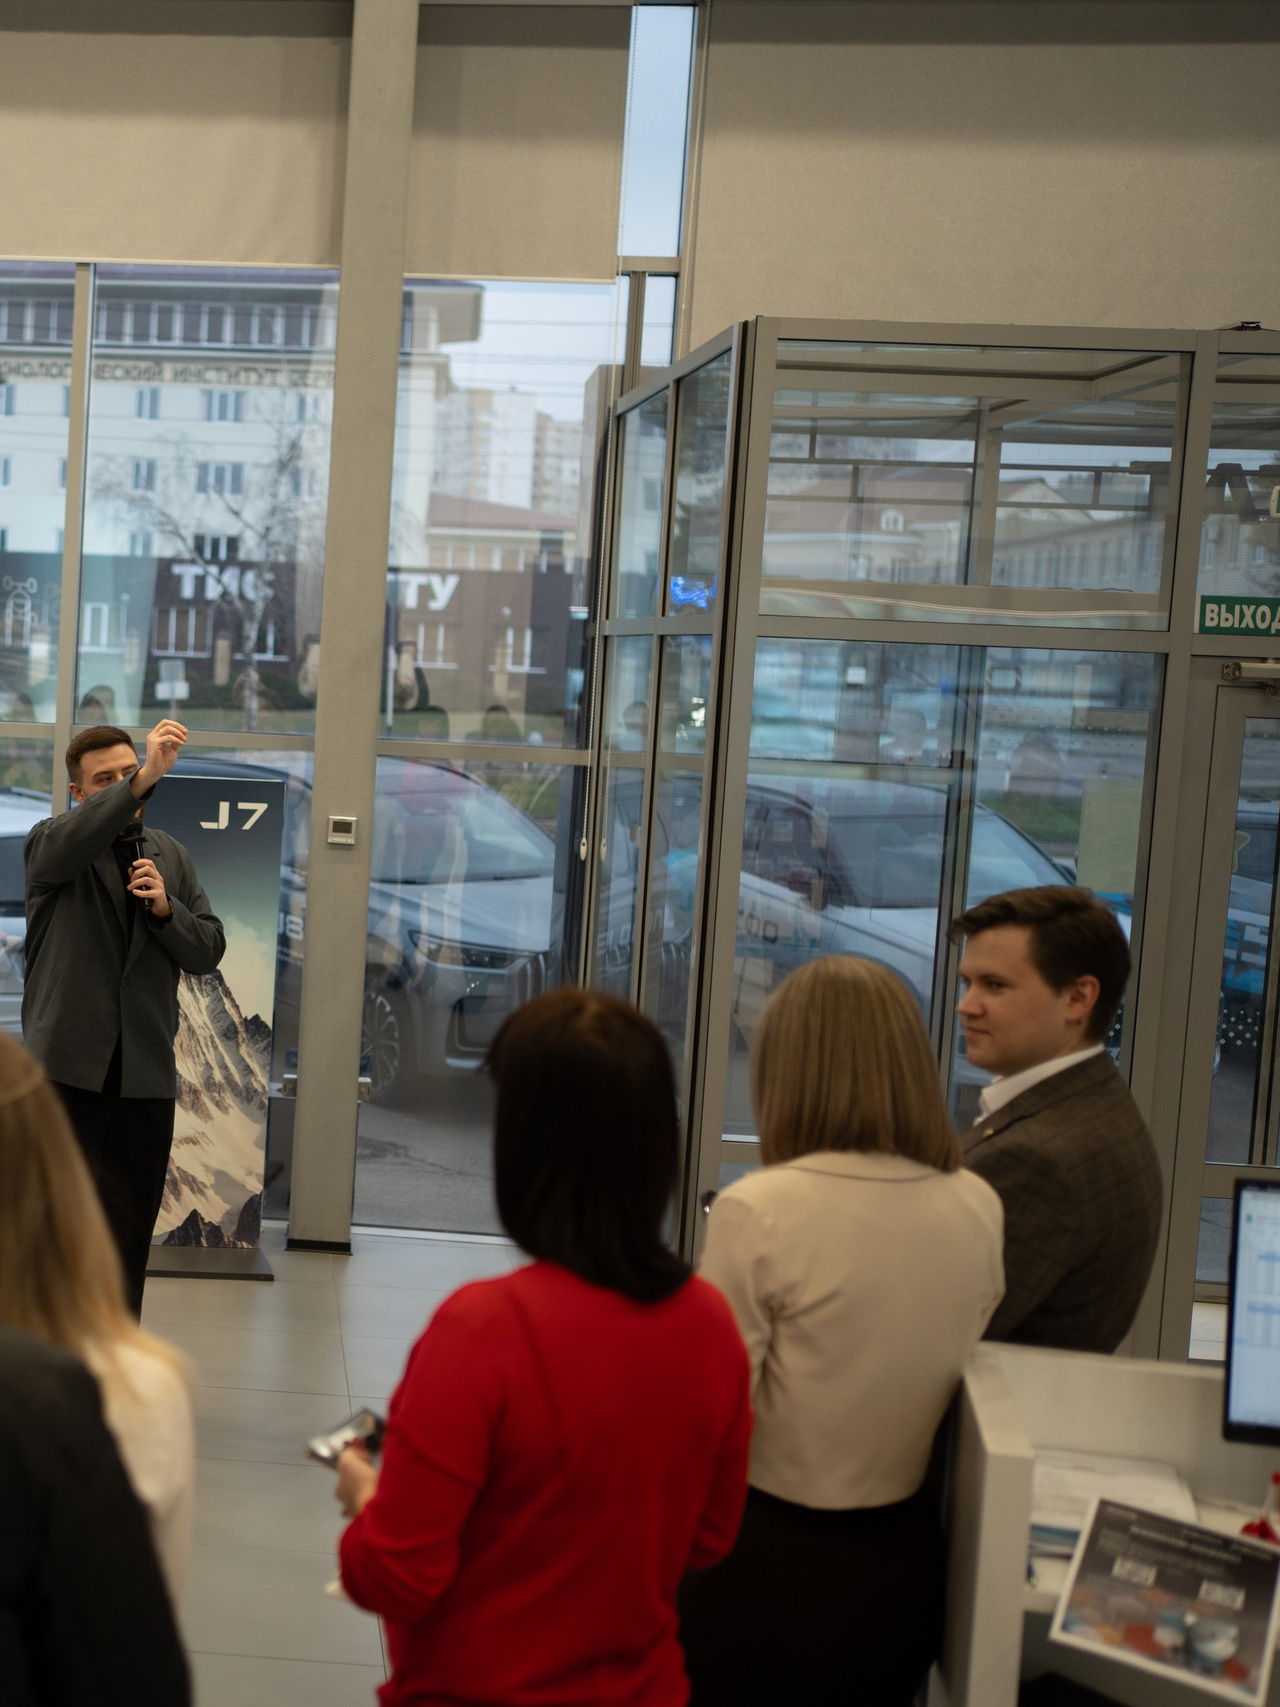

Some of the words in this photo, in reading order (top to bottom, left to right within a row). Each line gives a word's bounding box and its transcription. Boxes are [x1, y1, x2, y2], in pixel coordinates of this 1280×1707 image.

[171, 564, 275, 600] ТИС
[387, 573, 460, 611] ТУ
[200, 801, 269, 831] J7
